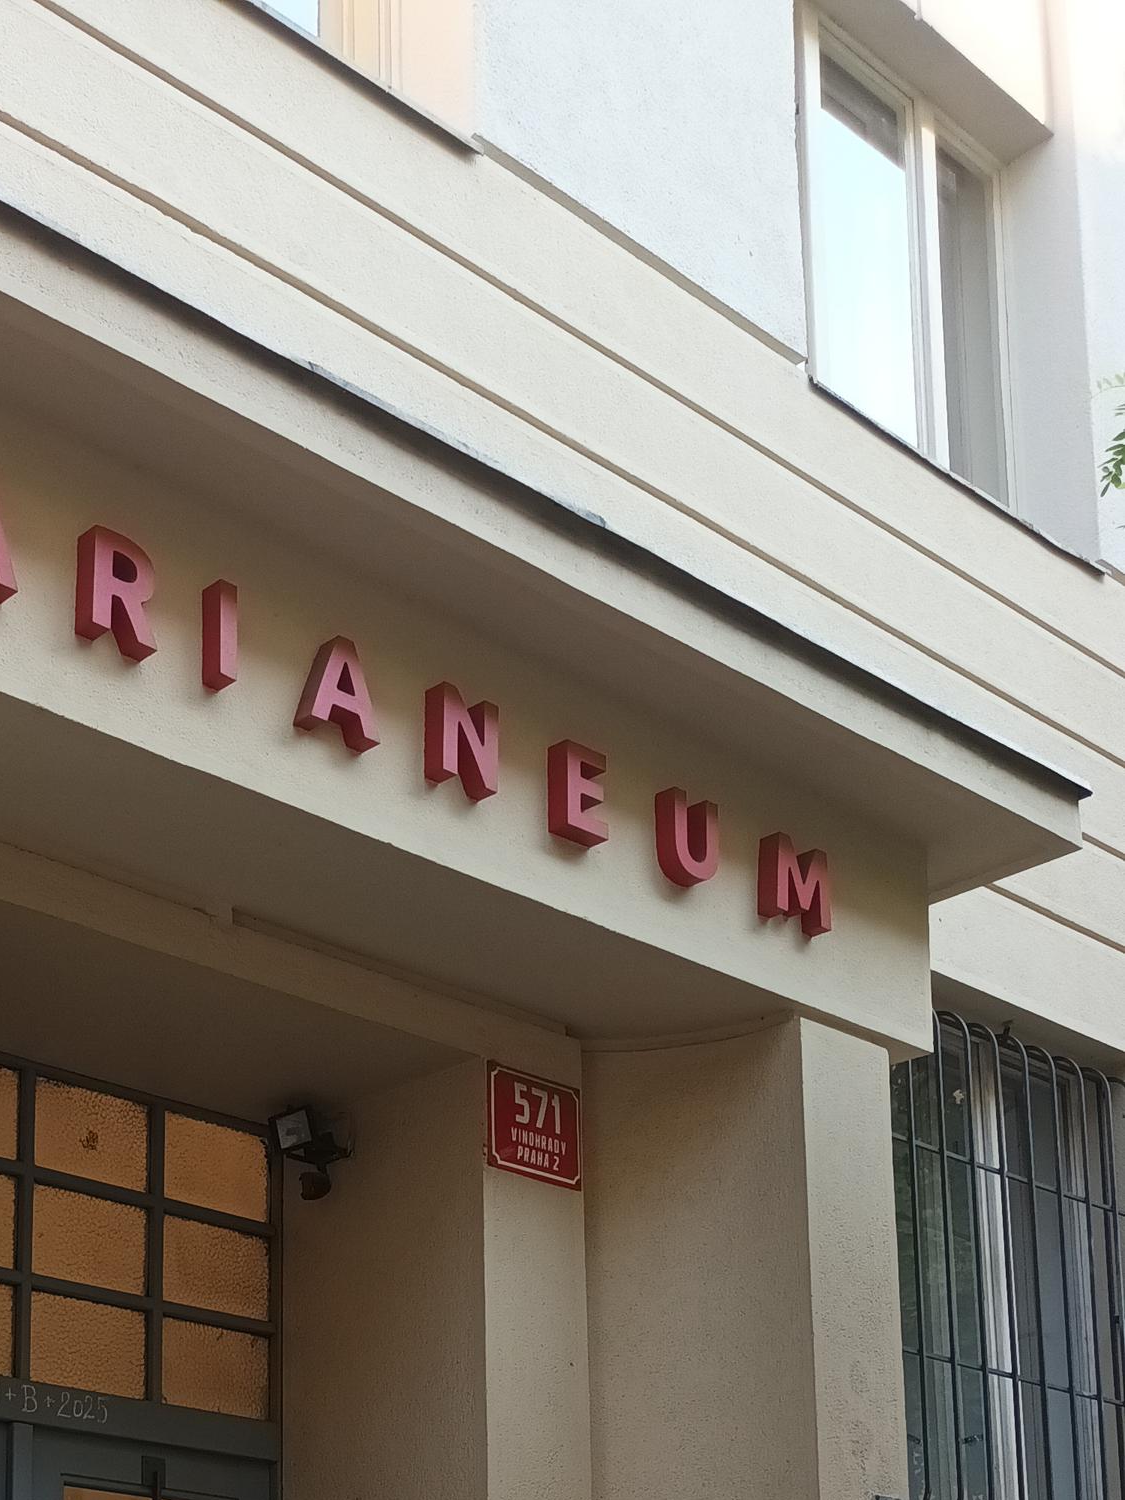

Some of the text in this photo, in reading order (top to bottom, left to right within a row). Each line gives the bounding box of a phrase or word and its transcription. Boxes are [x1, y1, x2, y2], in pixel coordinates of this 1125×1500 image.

[514, 1081, 561, 1134] 571
[511, 1127, 566, 1155] VINOHRADY
[517, 1145, 560, 1171] PRAHA 2
